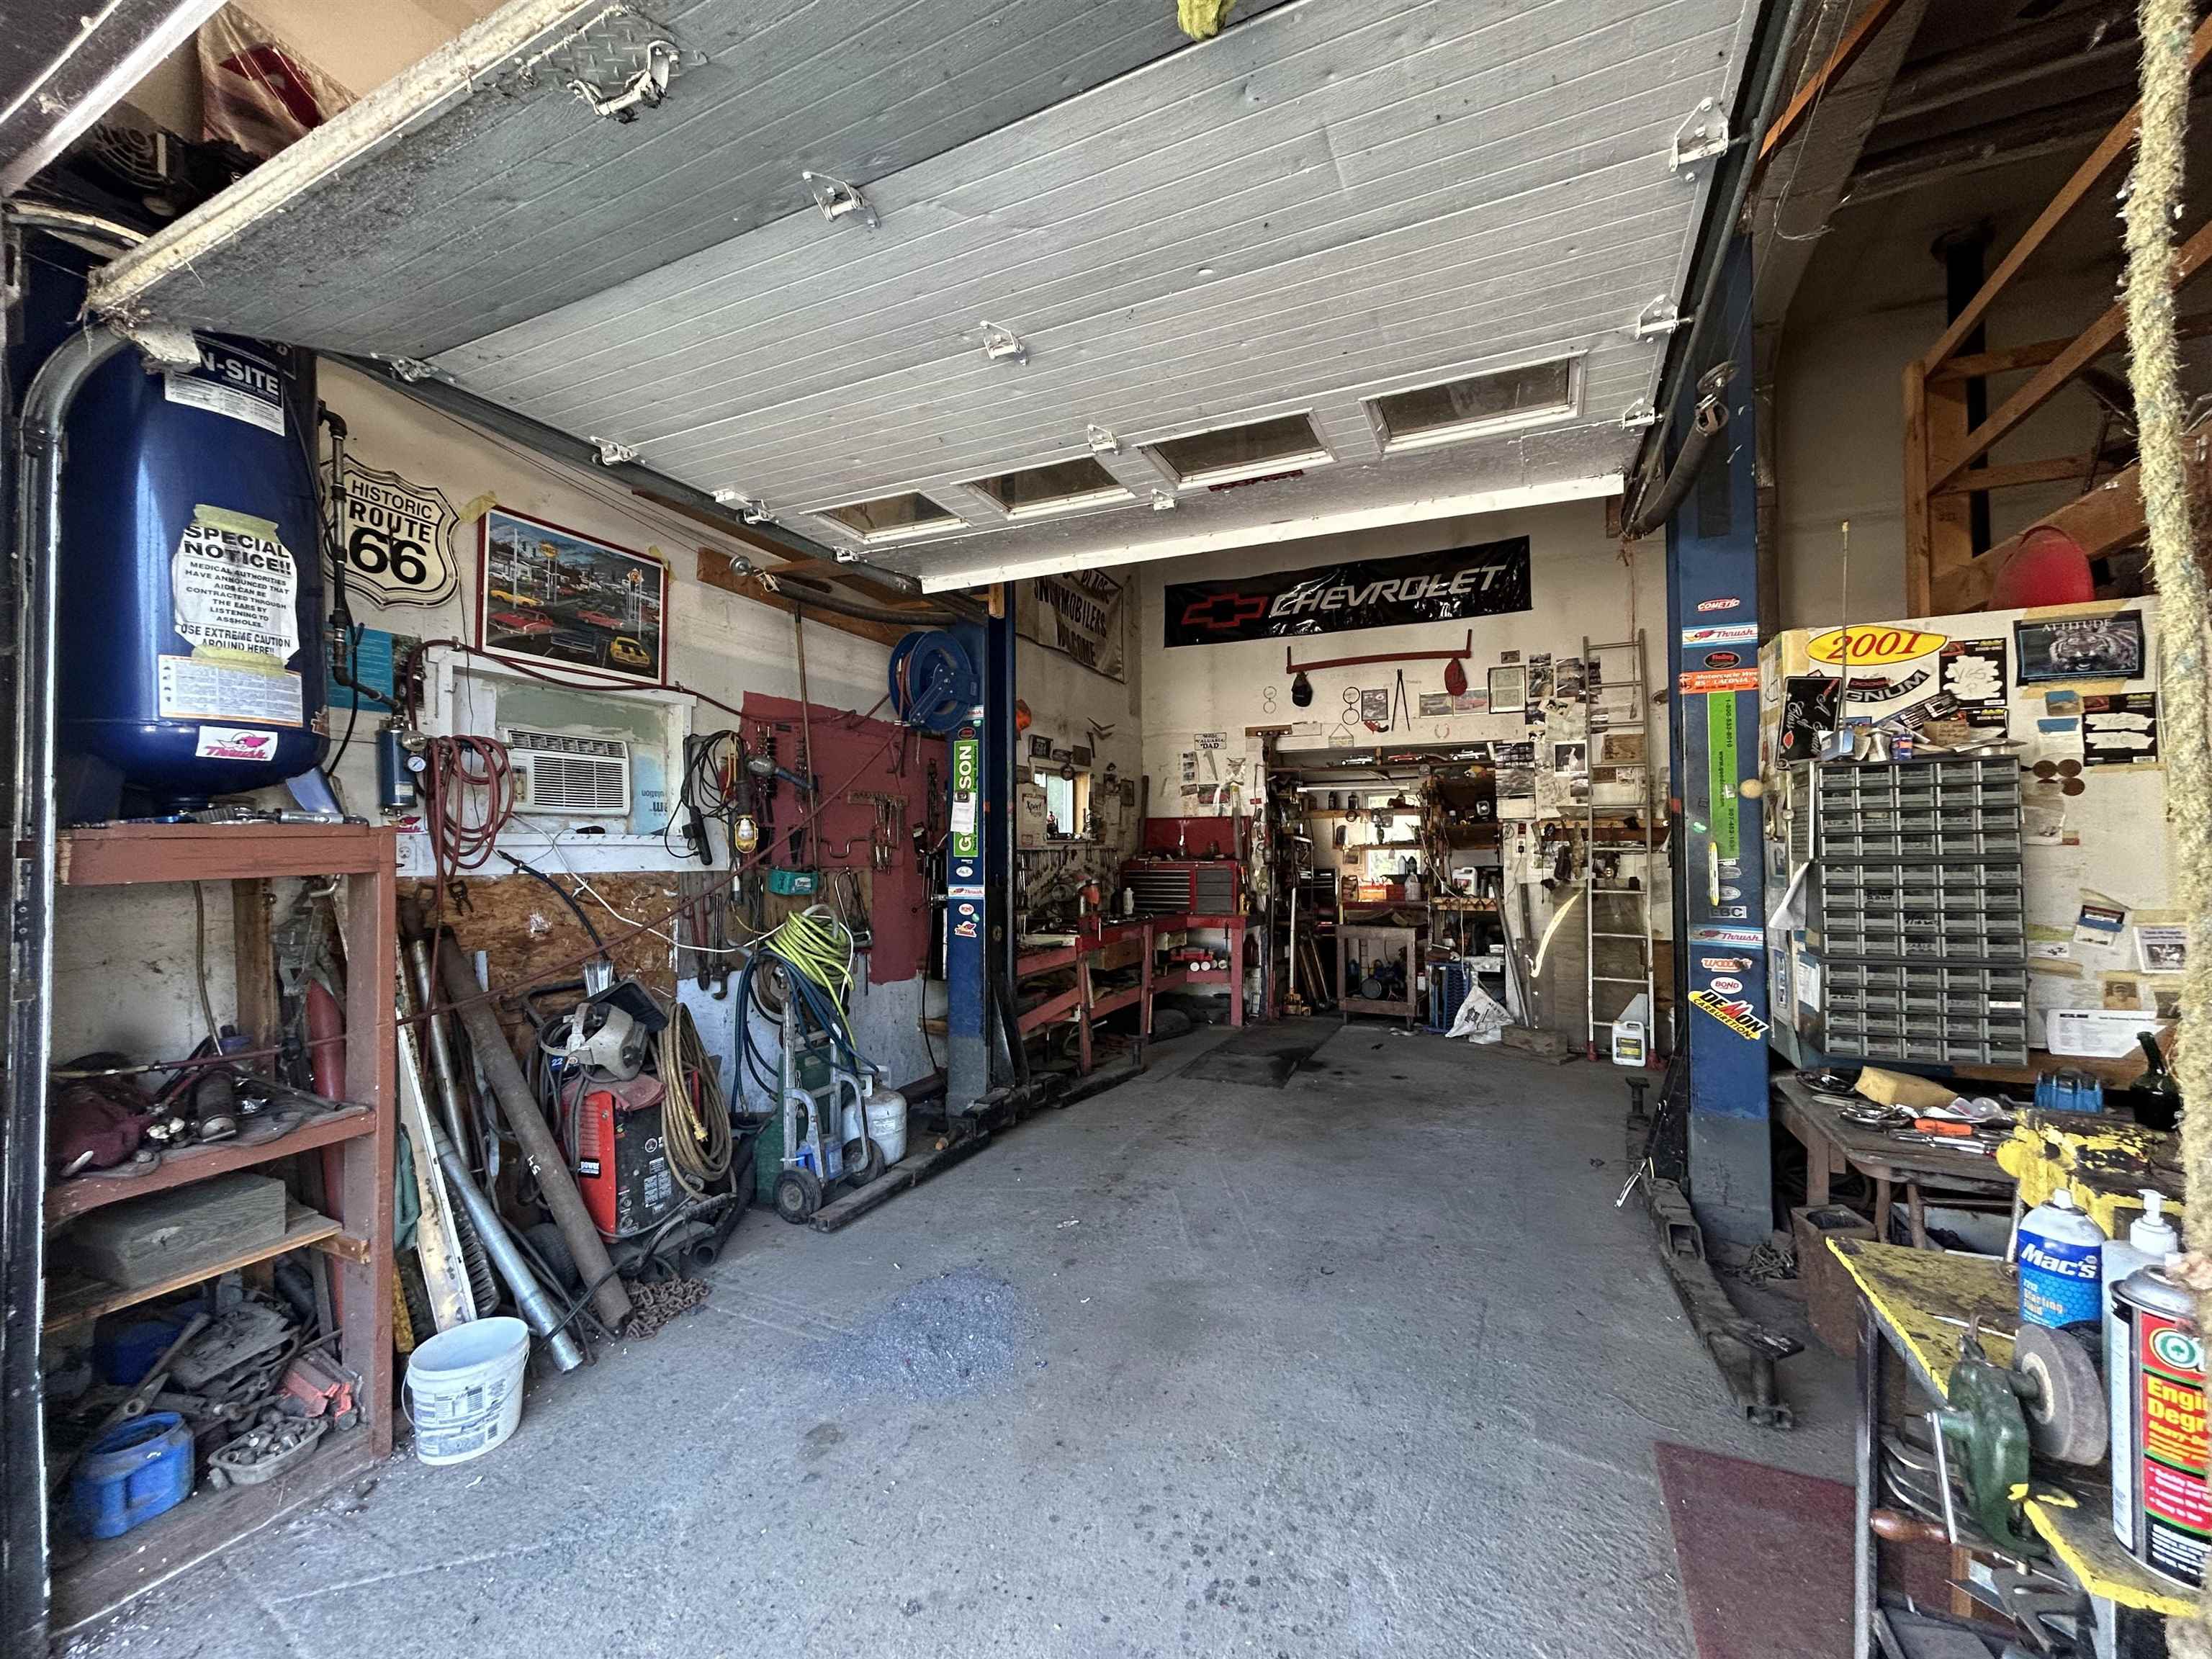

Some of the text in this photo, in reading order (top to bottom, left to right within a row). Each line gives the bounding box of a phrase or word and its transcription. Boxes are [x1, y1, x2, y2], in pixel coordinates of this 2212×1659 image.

[199, 350, 279, 396] N-SITE
[351, 480, 432, 519] HISTORIC
[349, 500, 431, 543] ROUTE
[184, 526, 289, 558] SPECIAL
[349, 526, 427, 585] 66
[184, 541, 291, 575] NOTICE!!
[185, 570, 290, 595] HAVE ANNOUNCED THAT
[190, 562, 287, 586] MEDICAL AUTHORITIES
[186, 587, 287, 610] CONTRACTED THROUGH
[214, 583, 235, 591] AIDS
[238, 587, 255, 596] CAN
[1269, 565, 1506, 619] CHEVROLET
[210, 607, 257, 620] LISTENING
[234, 602, 256, 612] EARS
[181, 624, 291, 647] USE EXTREME CAUTION
[1716, 628, 1753, 638] Thrush
[2042, 619, 2113, 632] ATTITUDE
[202, 639, 275, 656] AROUND HERE!!
[1826, 631, 1922, 660] 2001
[1696, 671, 1741, 680] Motorcycle
[1845, 672, 1927, 702] GNUM
[641, 790, 665, 799] ulation
[958, 745, 972, 852] GSON
[1721, 932, 1760, 941] Thrush
[1715, 981, 1740, 989] BOND
[1693, 999, 1752, 1038] CARBURETION
[1699, 992, 1767, 1033] DEMON
[2021, 1243, 2098, 1279] Mac's
[2147, 1374, 2208, 1412] Engi
